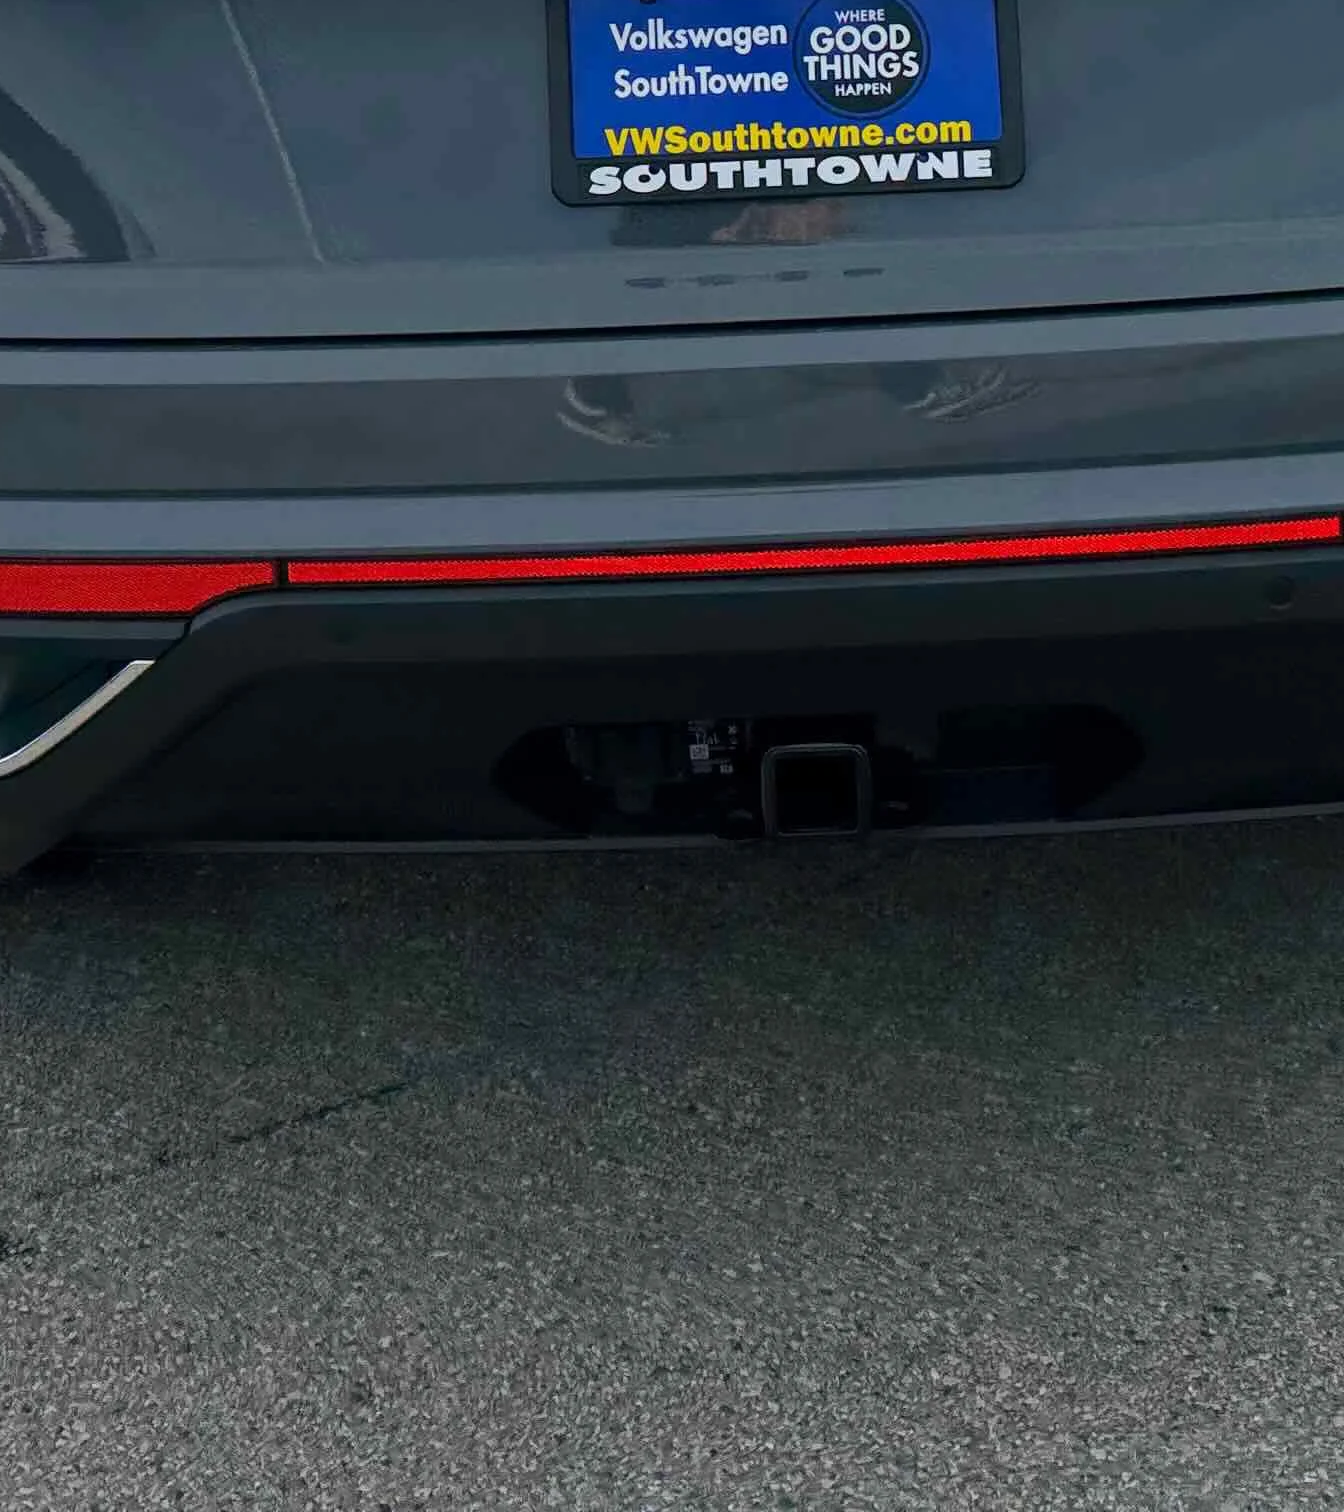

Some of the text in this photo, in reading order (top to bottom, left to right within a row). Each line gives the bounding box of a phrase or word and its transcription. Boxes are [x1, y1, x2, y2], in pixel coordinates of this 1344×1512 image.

[834, 8, 886, 25] WHERE
[608, 17, 789, 56] Volkswagen
[809, 23, 912, 55] GOOD
[613, 63, 790, 100] SouthTowne
[802, 50, 921, 82] THINGS
[834, 81, 893, 98] HAPPEN
[603, 119, 973, 158] VWSouthtowne.com
[587, 148, 994, 197] SOUTHTOWNE
